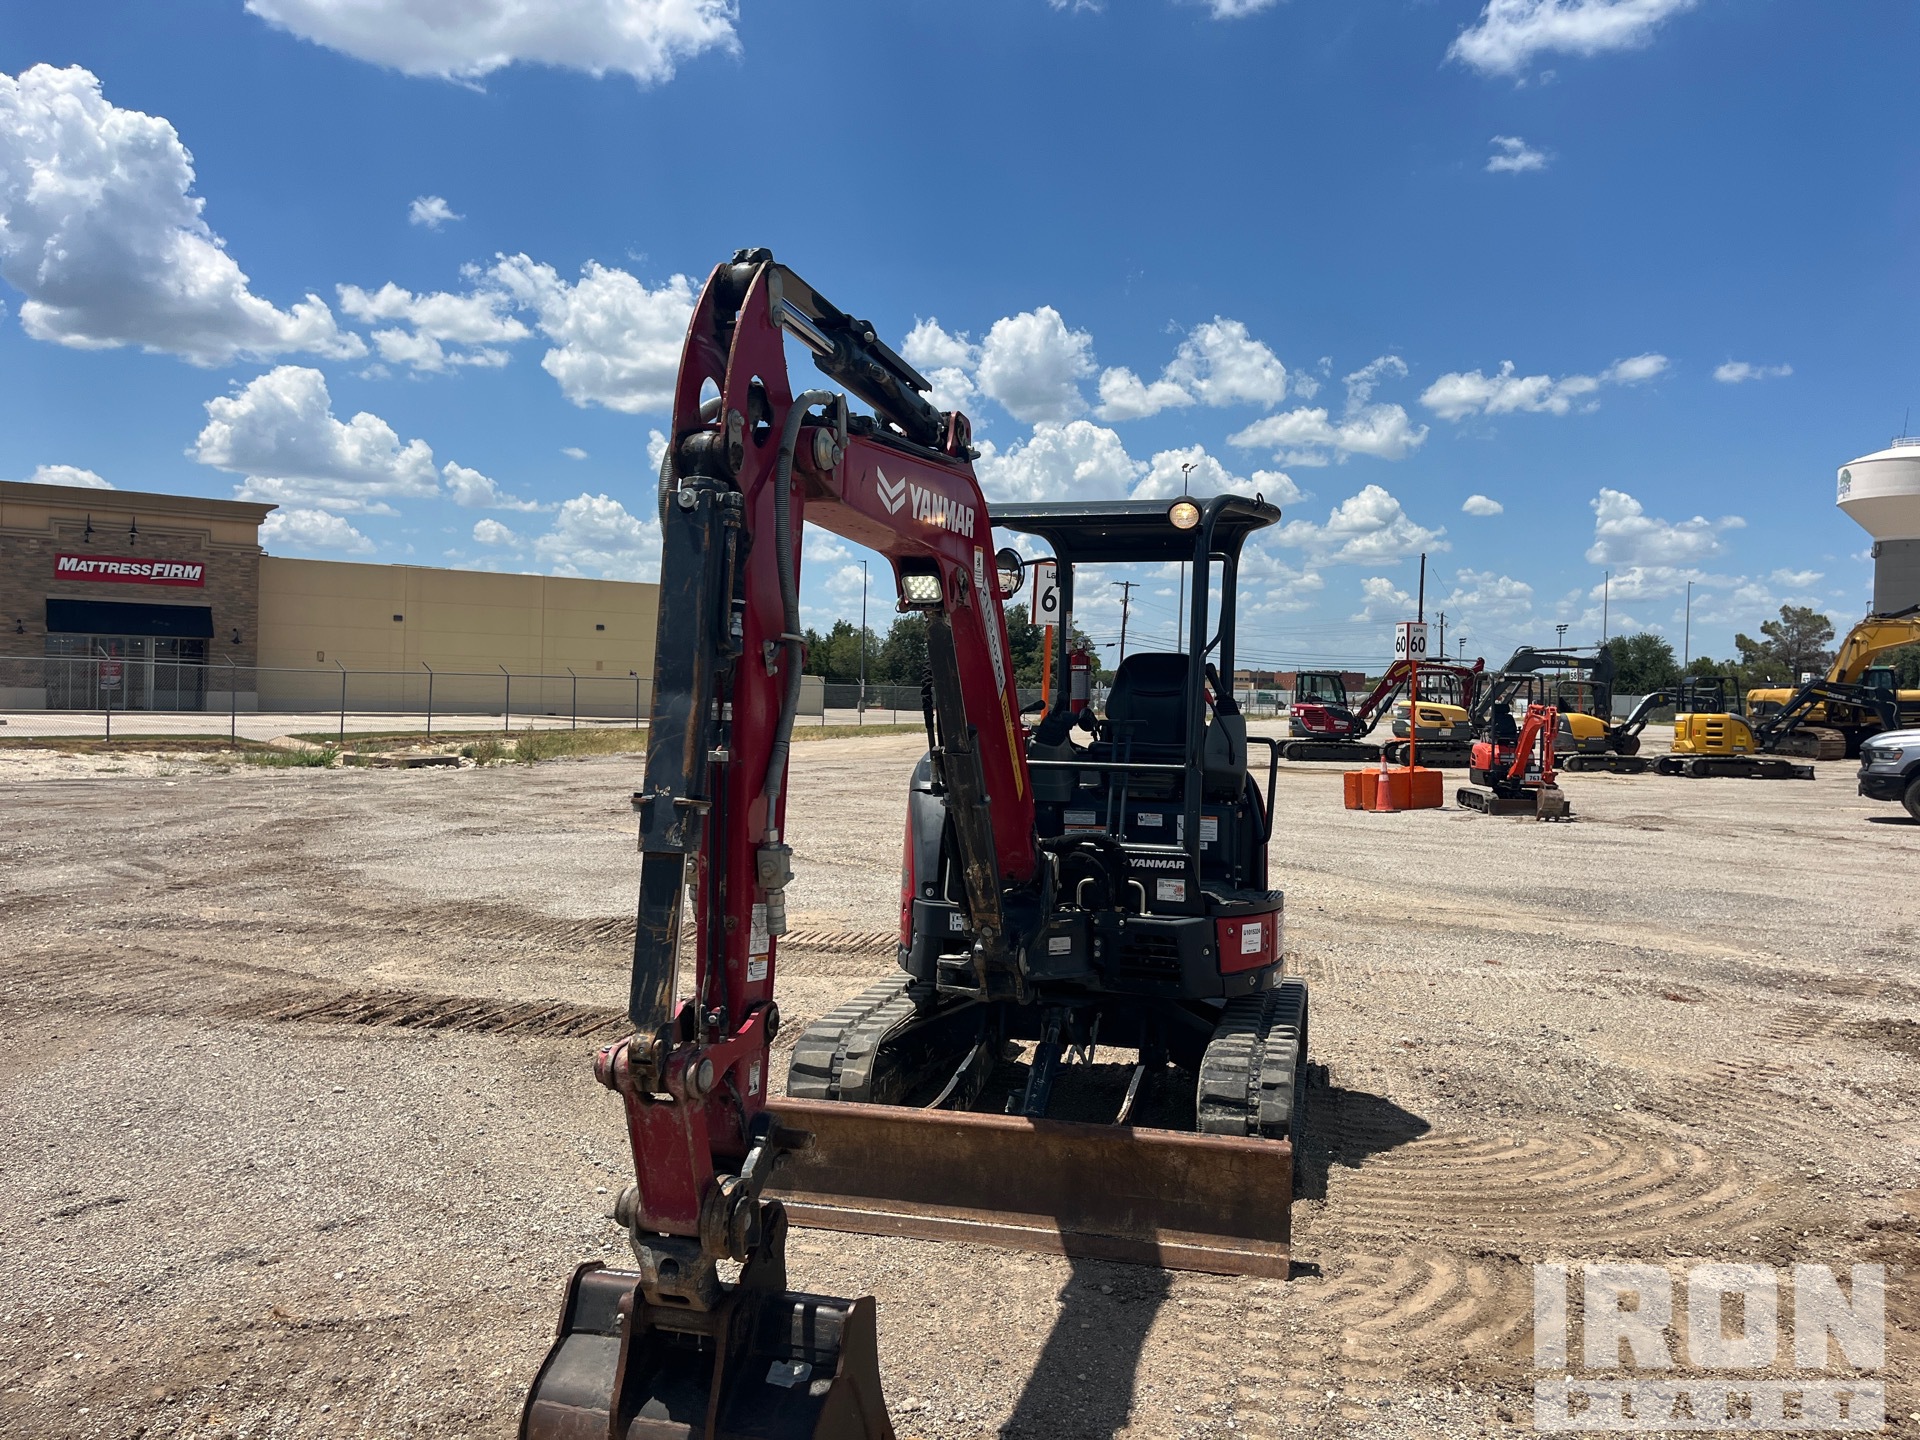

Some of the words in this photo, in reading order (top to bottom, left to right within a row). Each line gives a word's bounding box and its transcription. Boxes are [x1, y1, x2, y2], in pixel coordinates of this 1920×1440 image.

[909, 482, 975, 539] YANMAR
[1395, 635, 1406, 653] 60
[1410, 636, 1426, 653] 60
[1129, 858, 1185, 869] YANMAR
